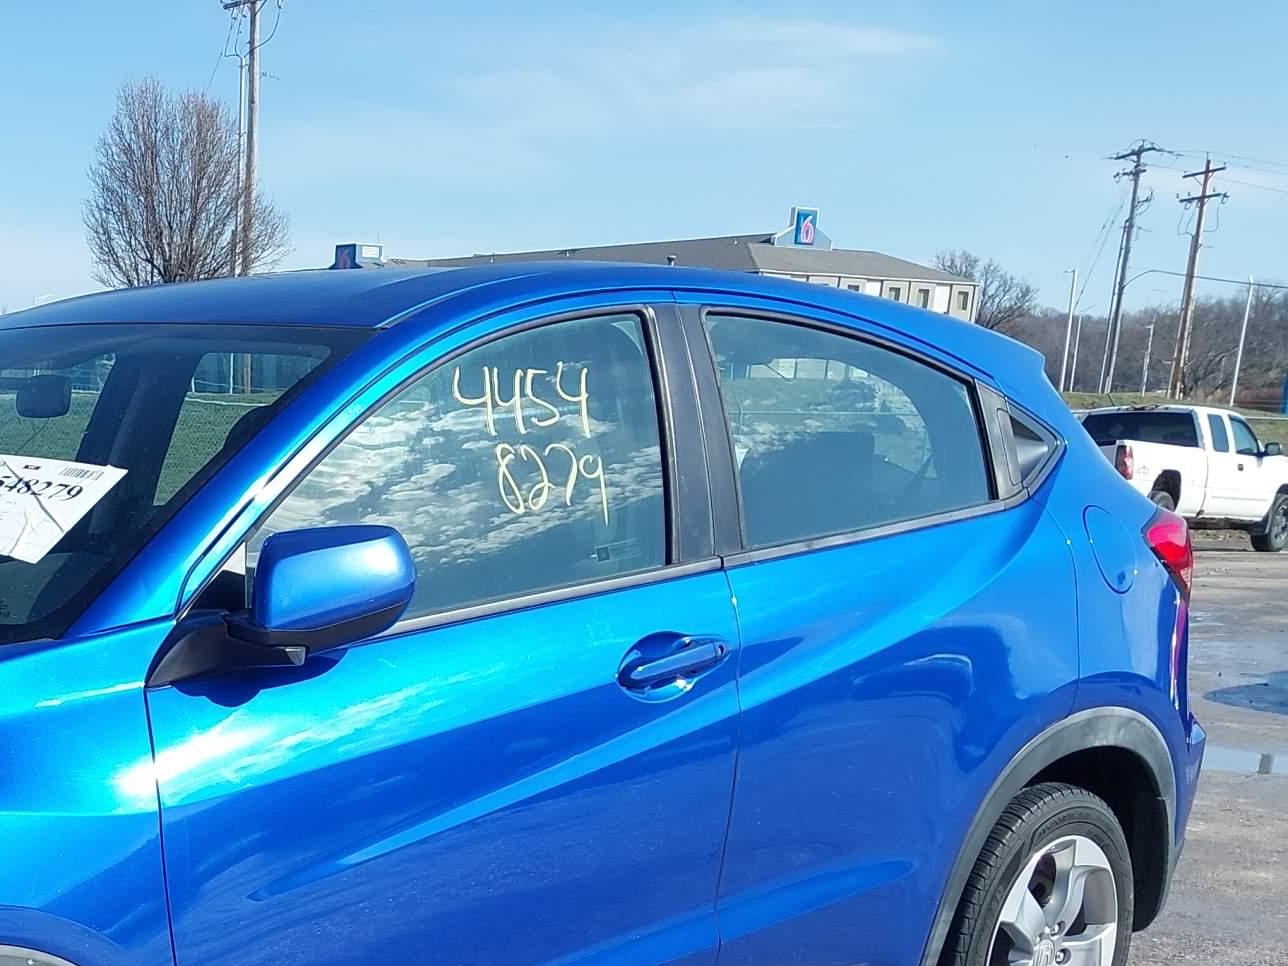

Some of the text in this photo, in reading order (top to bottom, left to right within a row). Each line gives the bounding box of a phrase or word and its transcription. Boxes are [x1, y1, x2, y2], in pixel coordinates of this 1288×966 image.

[801, 215, 814, 243] 6
[452, 361, 592, 439] 4454
[496, 443, 609, 527] 8279
